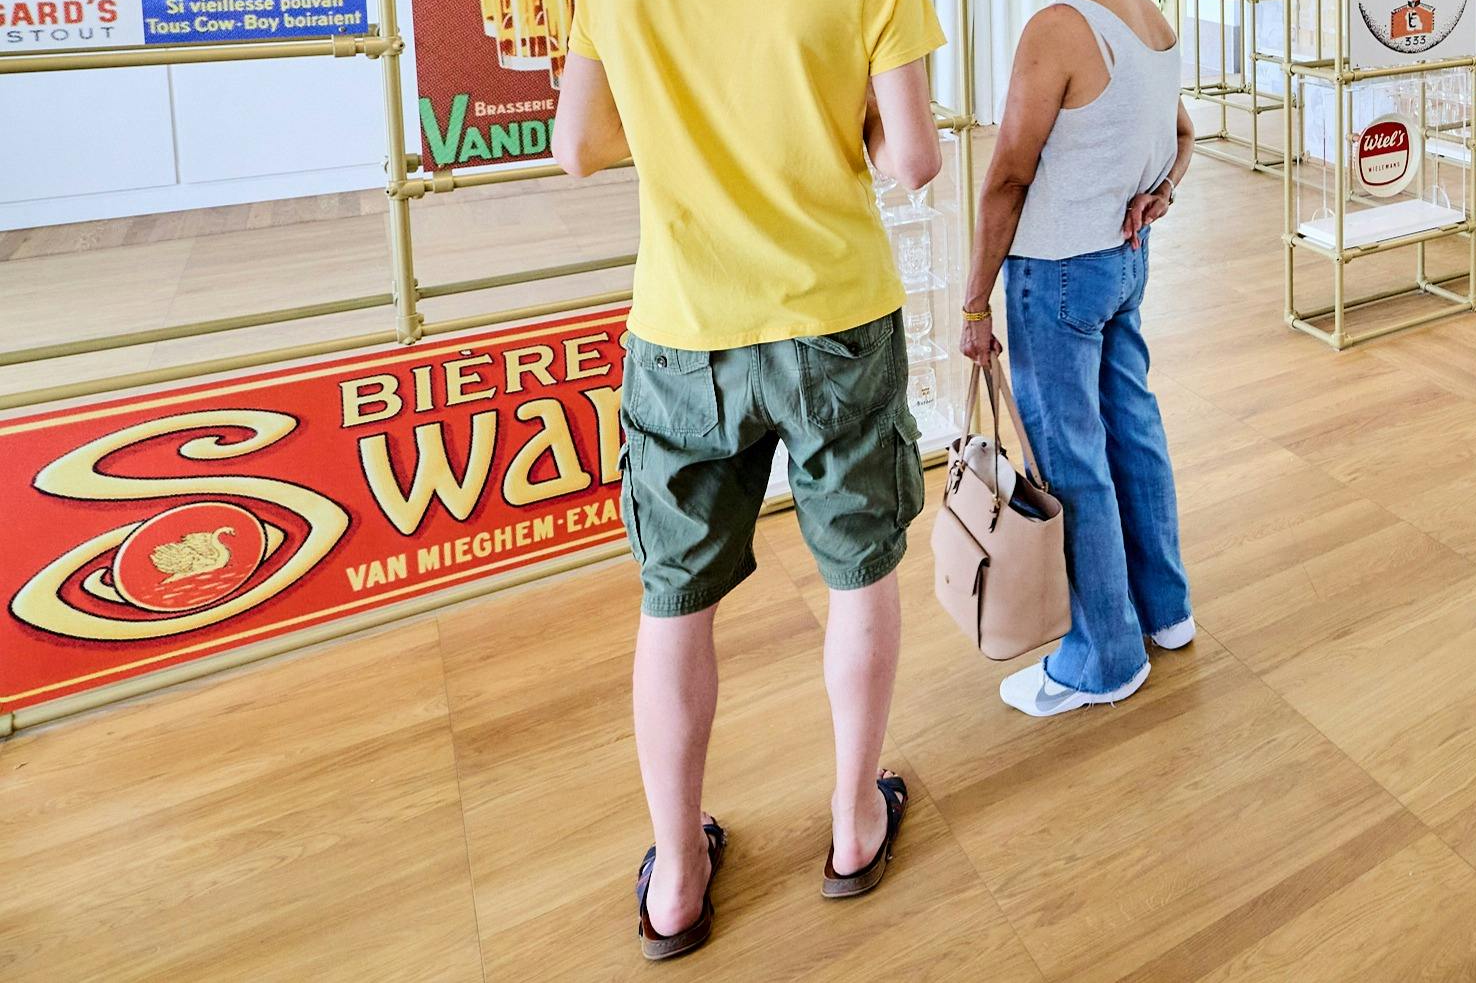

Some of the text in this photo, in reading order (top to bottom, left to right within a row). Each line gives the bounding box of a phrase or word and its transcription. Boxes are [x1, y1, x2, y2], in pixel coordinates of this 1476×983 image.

[146, 18, 190, 34] Tous
[283, 11, 362, 27] boiraient
[7, 26, 114, 44] STOUT
[1404, 35, 1427, 46] 333
[474, 99, 555, 116] BRASSERIE
[1363, 129, 1406, 152] Wiel's
[339, 331, 629, 428] BIÈRE
[346, 554, 408, 591] VAN
